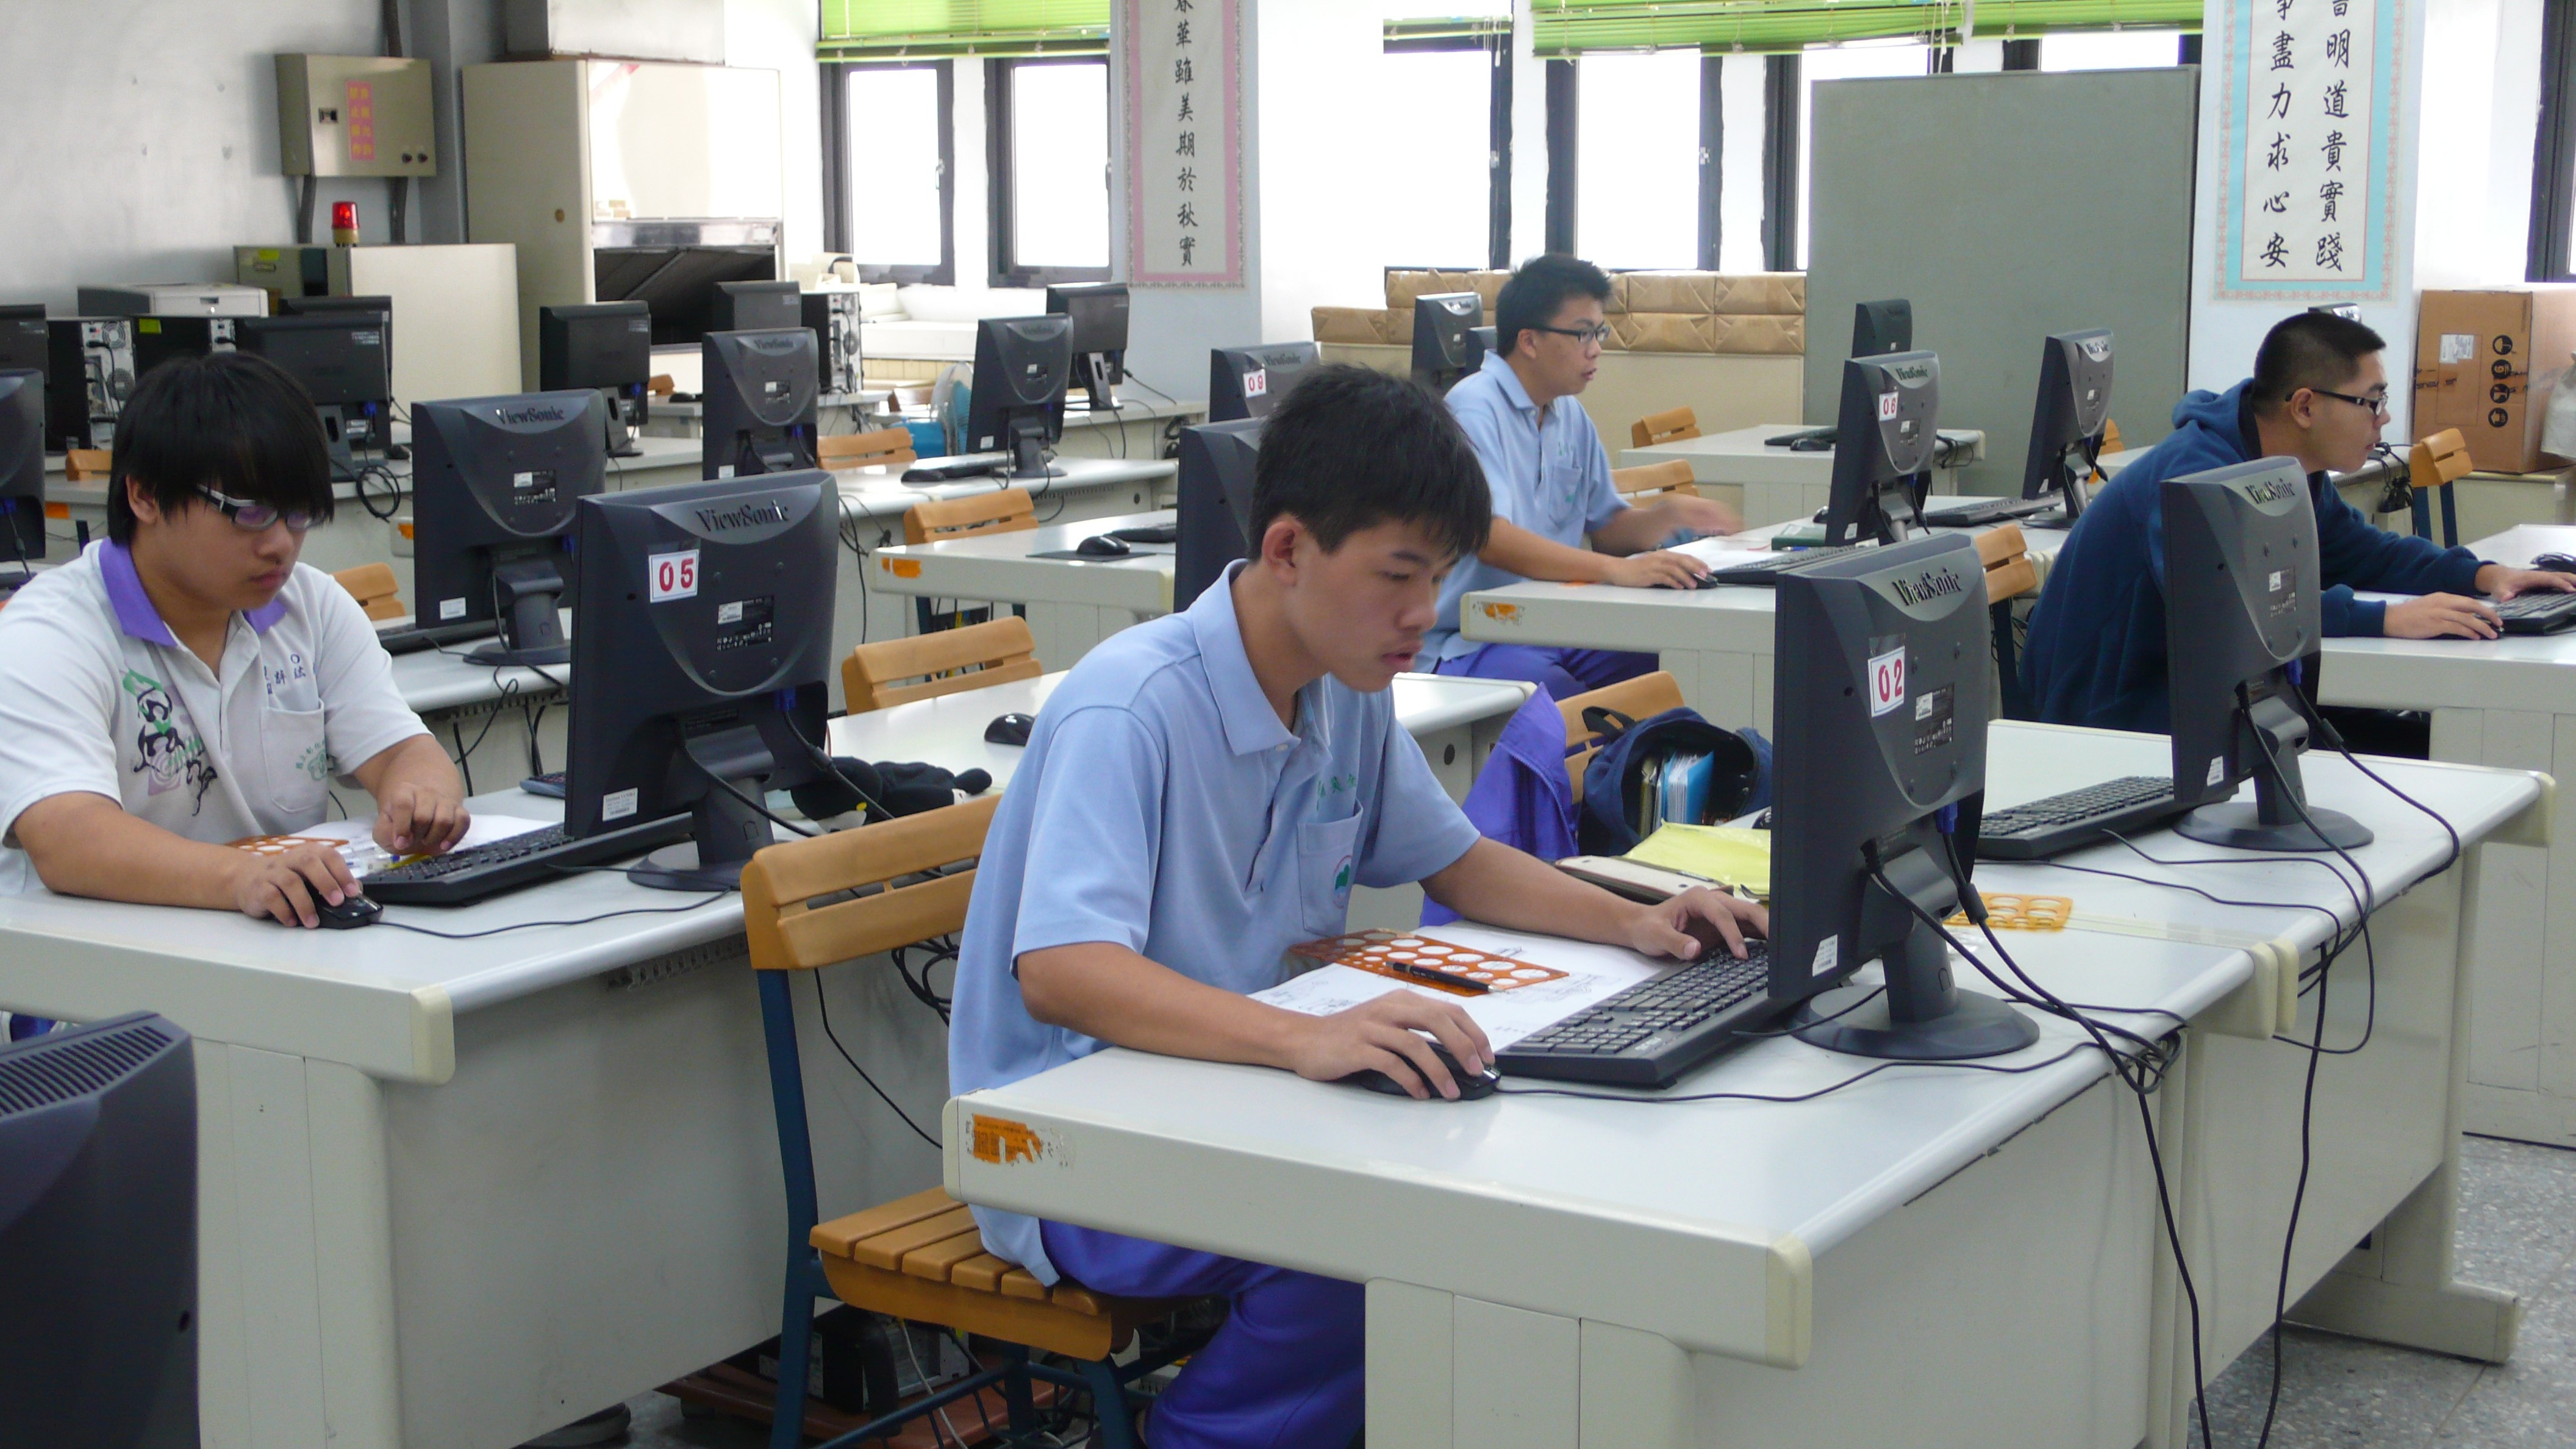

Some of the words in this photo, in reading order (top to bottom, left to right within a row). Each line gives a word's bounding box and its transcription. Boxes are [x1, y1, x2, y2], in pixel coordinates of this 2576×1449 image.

[1248, 374, 1264, 392] 09
[495, 405, 566, 425] ViewSonic
[1883, 397, 1896, 415] 06
[2245, 478, 2295, 504] ViewSonic
[695, 499, 789, 532] ViewSonic
[659, 557, 694, 592] 05
[1892, 567, 1964, 607] ViewSonic
[1878, 658, 1903, 703] 02
